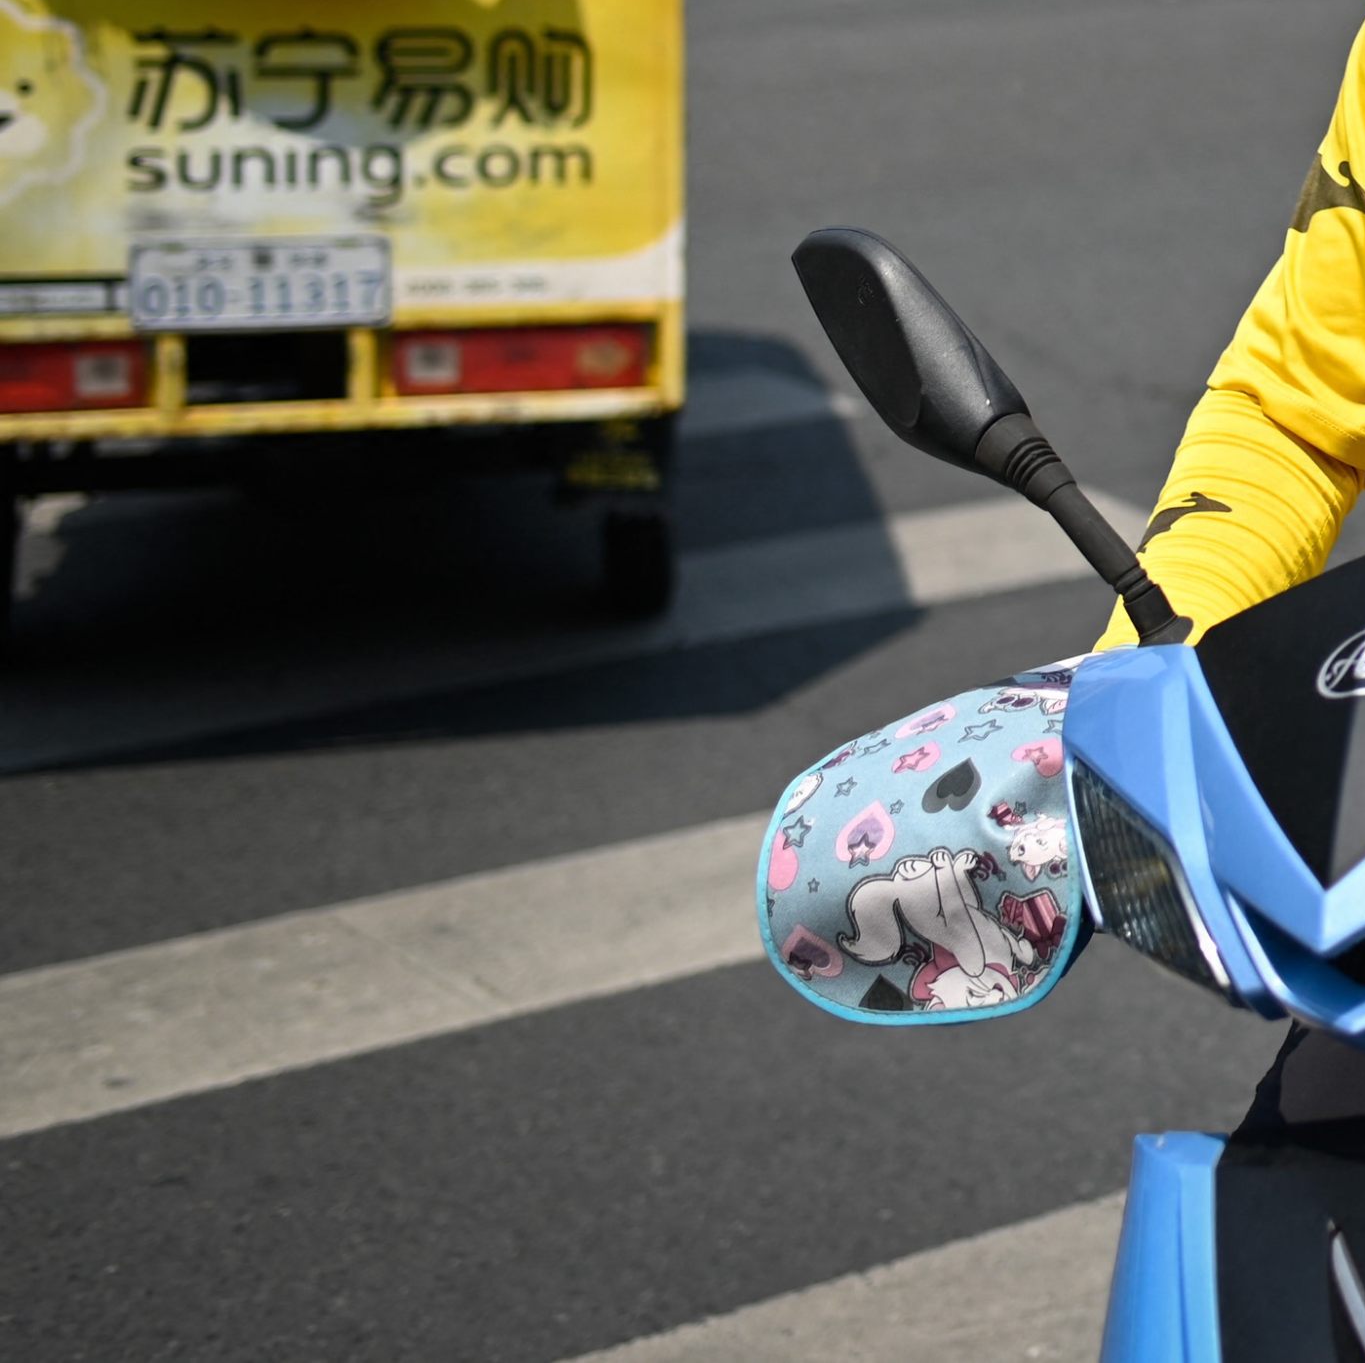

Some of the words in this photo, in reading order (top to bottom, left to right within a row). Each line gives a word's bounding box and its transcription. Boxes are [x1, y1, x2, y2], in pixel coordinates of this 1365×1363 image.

[128, 29, 594, 131] 苏宁易购
[128, 144, 593, 208] suning.com
